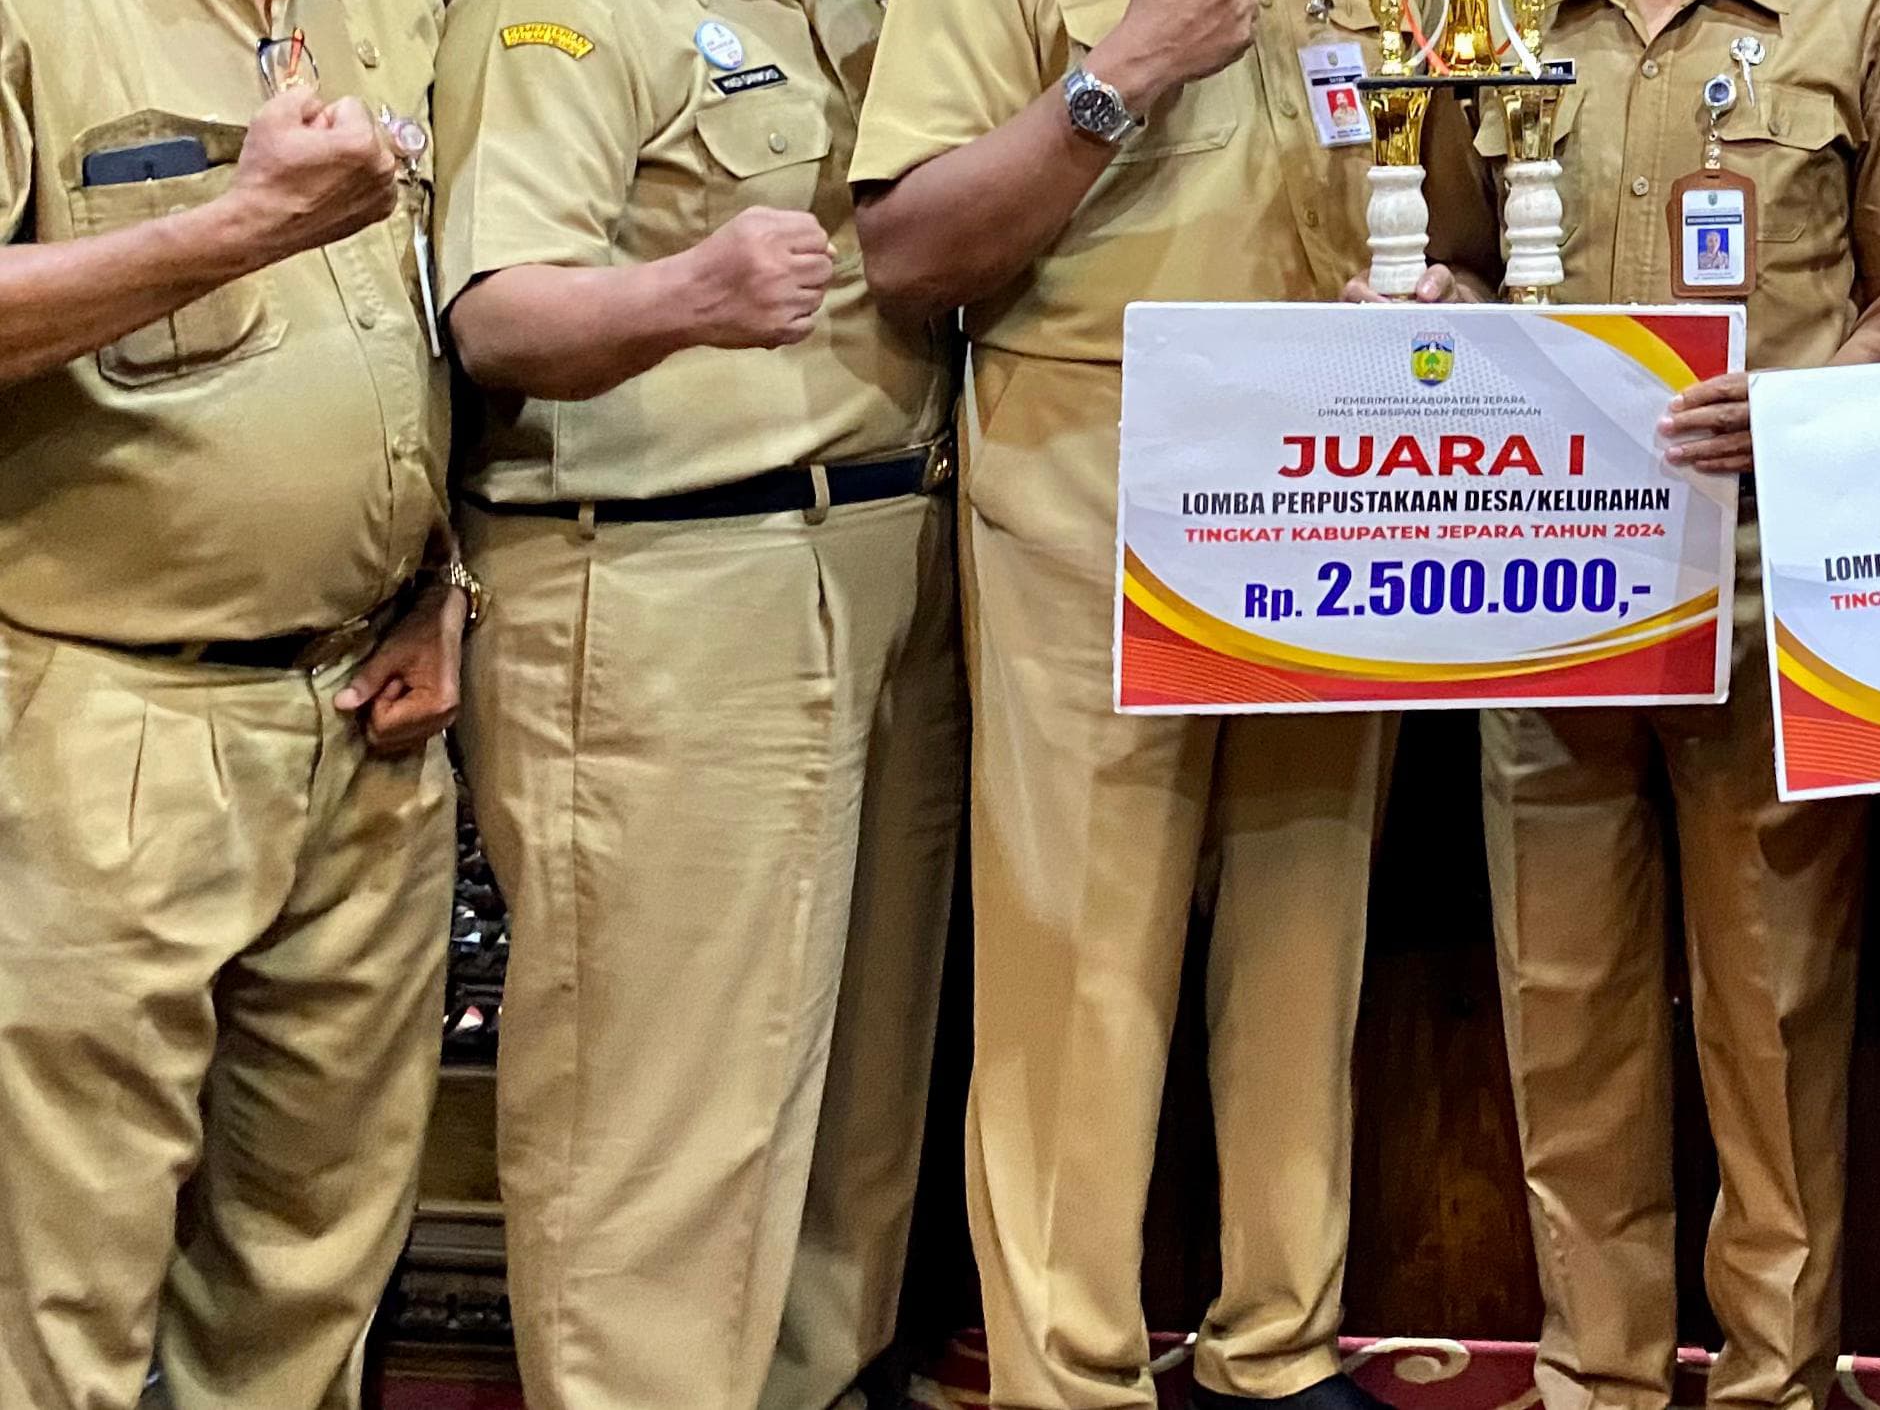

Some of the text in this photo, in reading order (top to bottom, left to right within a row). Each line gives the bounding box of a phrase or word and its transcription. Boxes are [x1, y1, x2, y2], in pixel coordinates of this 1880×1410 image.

[1317, 407, 1542, 417] DINAS KEARSIPAN DAN PERPUSTAKAAN
[1334, 395, 1526, 405] PEMERINTAH KABUPATEN JEPARA
[1277, 434, 1585, 478] JUARA I
[1182, 487, 1671, 516] LOMBA PERPUSTAKAAN DESA/KELURAHAN
[1185, 523, 1666, 543] TINGKAT KABUPATEN JEPARA TAHUN 2024
[1244, 557, 1651, 622] Rp. 2.500.000,-
